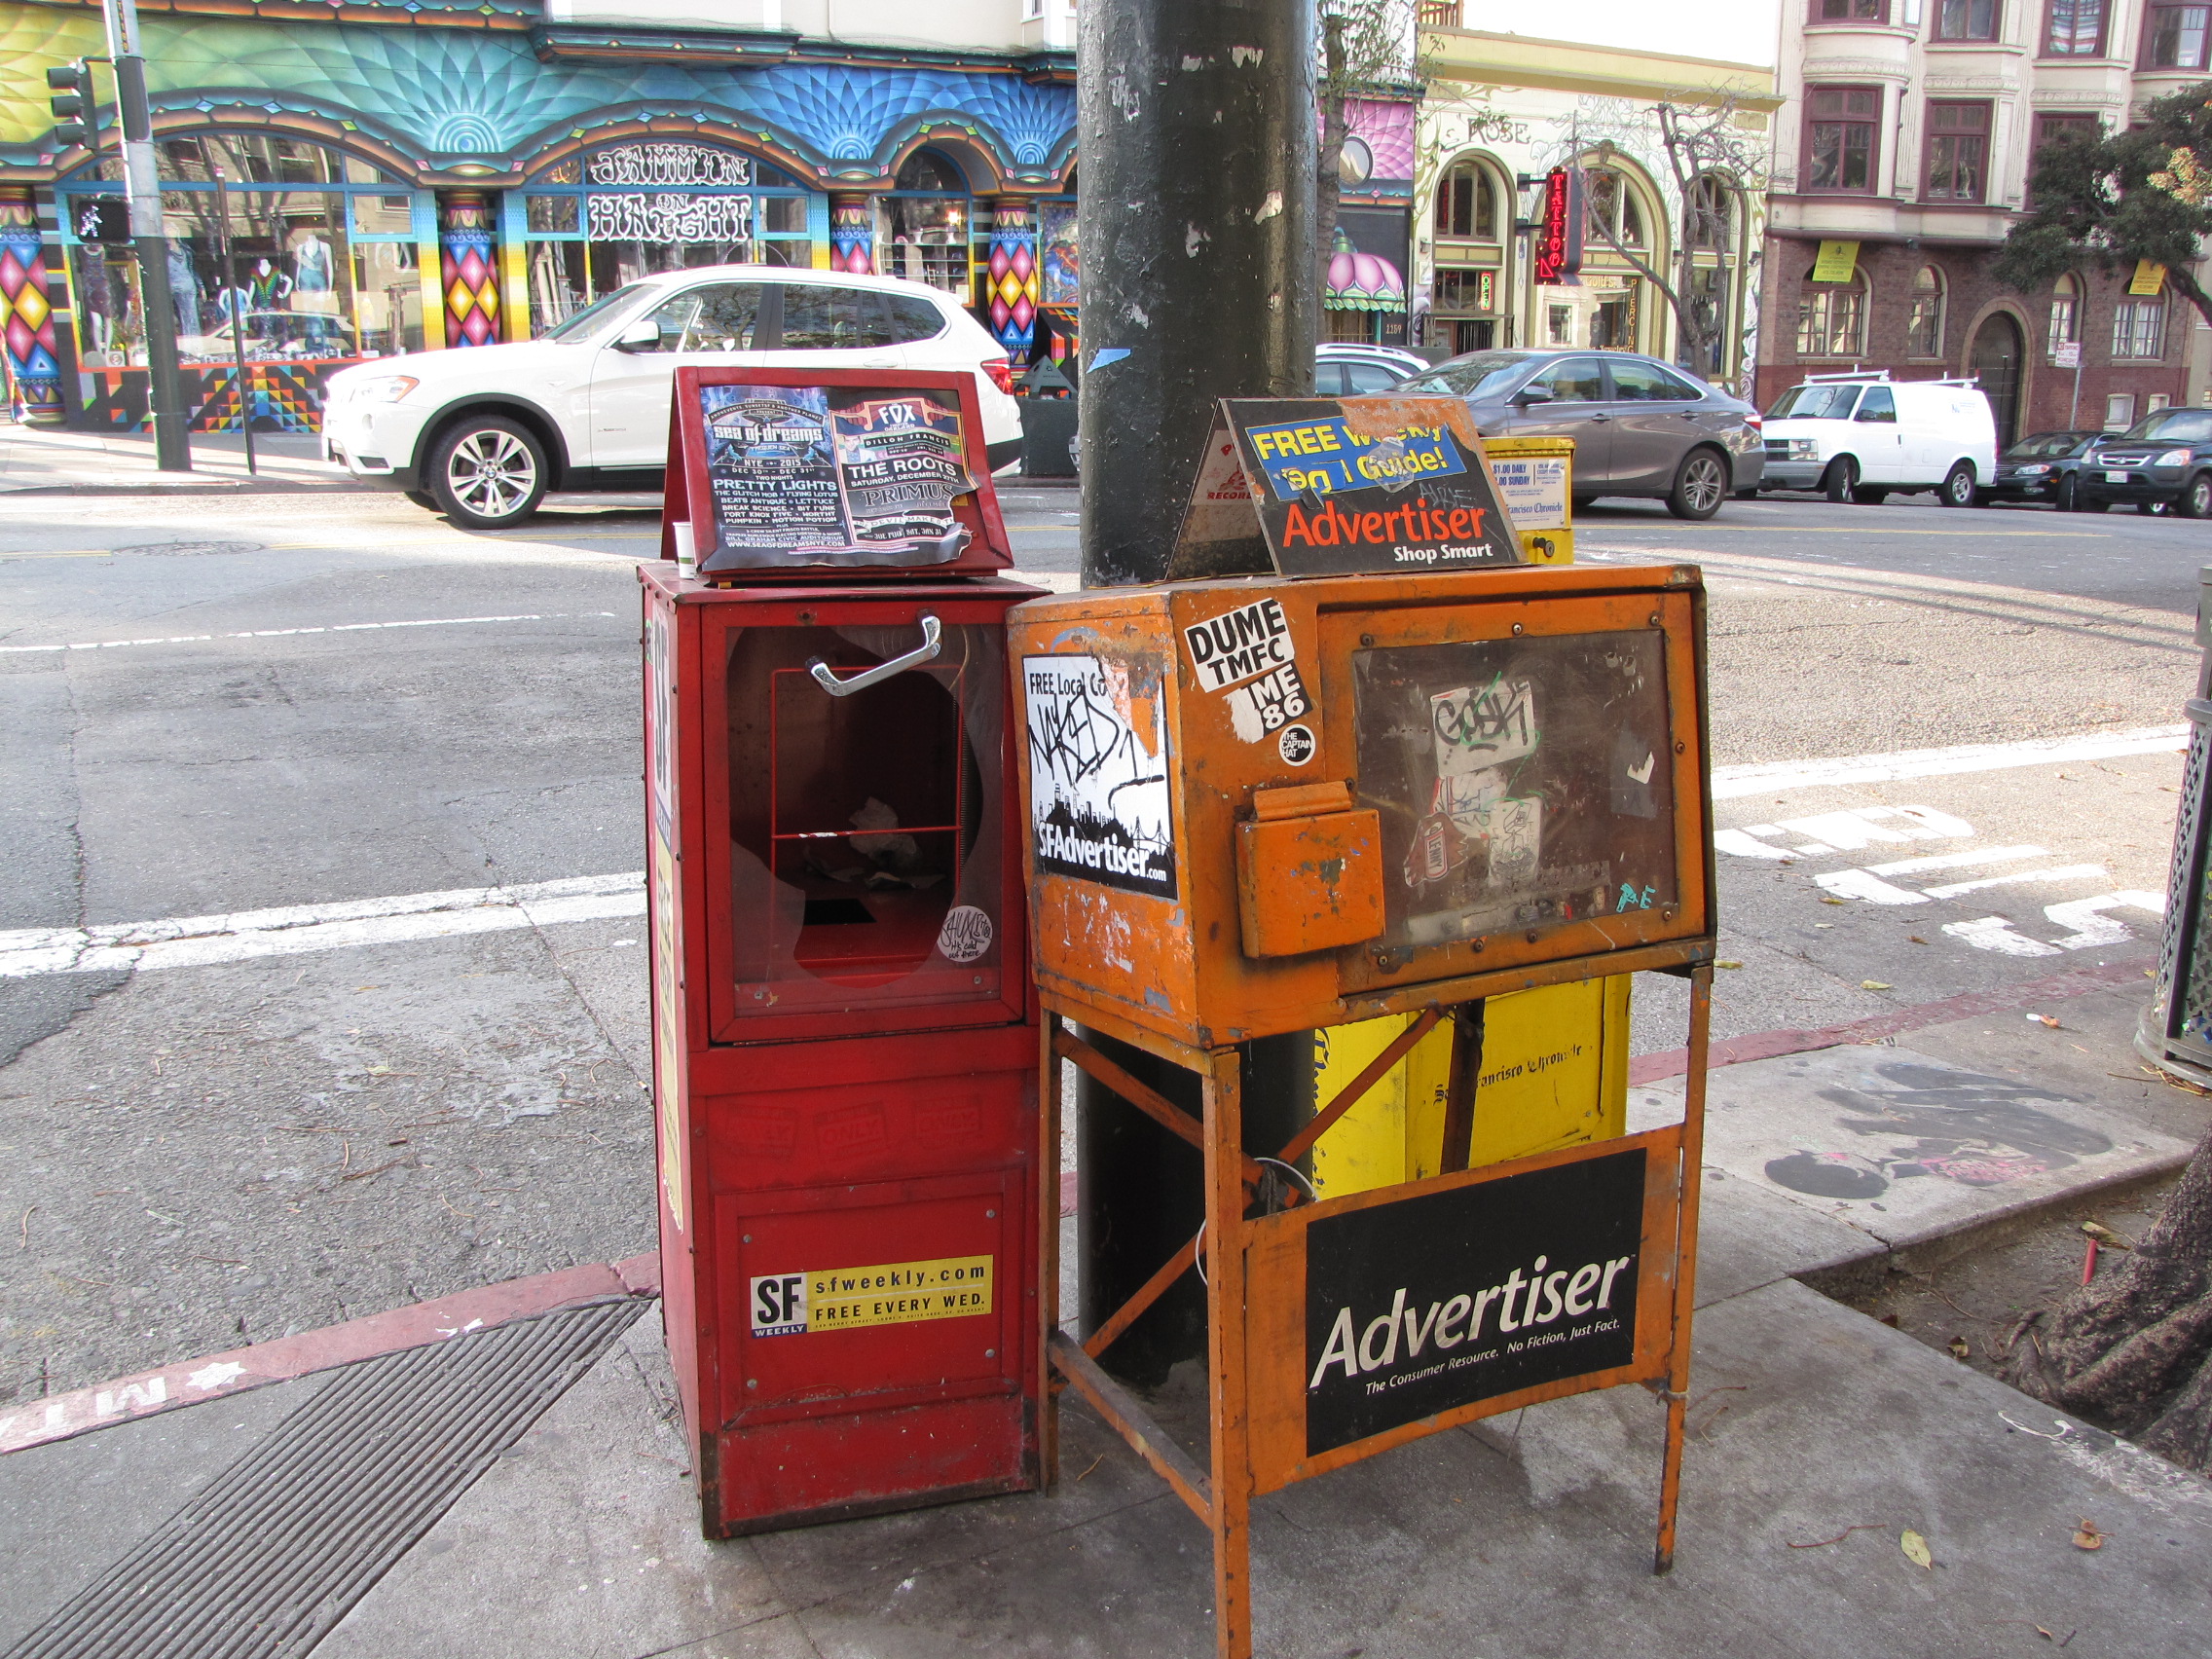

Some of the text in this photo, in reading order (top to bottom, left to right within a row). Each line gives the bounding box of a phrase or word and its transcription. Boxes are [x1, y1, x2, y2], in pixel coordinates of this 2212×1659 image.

[590, 144, 750, 186] JAMMIN
[588, 193, 752, 243] HAIGHT
[1549, 173, 1564, 268] TATTOO
[1482, 275, 1491, 310] OPEN
[878, 402, 917, 425] FOX
[715, 423, 824, 446] sea of dreams
[865, 436, 903, 447] DILLON
[909, 433, 950, 446] FRANCIS
[1252, 424, 1342, 461] FREE
[780, 459, 801, 467] 2015
[848, 457, 957, 479] THE ROOTS
[714, 479, 837, 492] PRETTY LIGHTS
[850, 475, 896, 488] SATURDAY,
[897, 471, 942, 482] DECEMBER
[864, 484, 954, 507] PRIMUS
[1282, 498, 1486, 548] Advertiser
[1393, 542, 1494, 564] Shop Smart
[1187, 599, 1287, 665] DUME
[1207, 637, 1285, 685] TMFC
[1029, 673, 1054, 695] FREE
[1262, 691, 1306, 730] 86
[1281, 740, 1313, 750] CAPTAIN
[1283, 732, 1298, 741] THE
[1281, 749, 1298, 758] HAT
[1038, 819, 1167, 883] SFAdvertiser.com
[815, 1265, 985, 1295] sfweekly.com
[756, 1277, 803, 1325] SF
[814, 1292, 986, 1321] FREE EVERY WED.
[755, 1324, 805, 1338] WEEKLY
[1308, 1254, 1631, 1389] Advertiser
[1365, 1318, 1621, 1396] The Consumer Resource. No Fiction, Just Fact.
